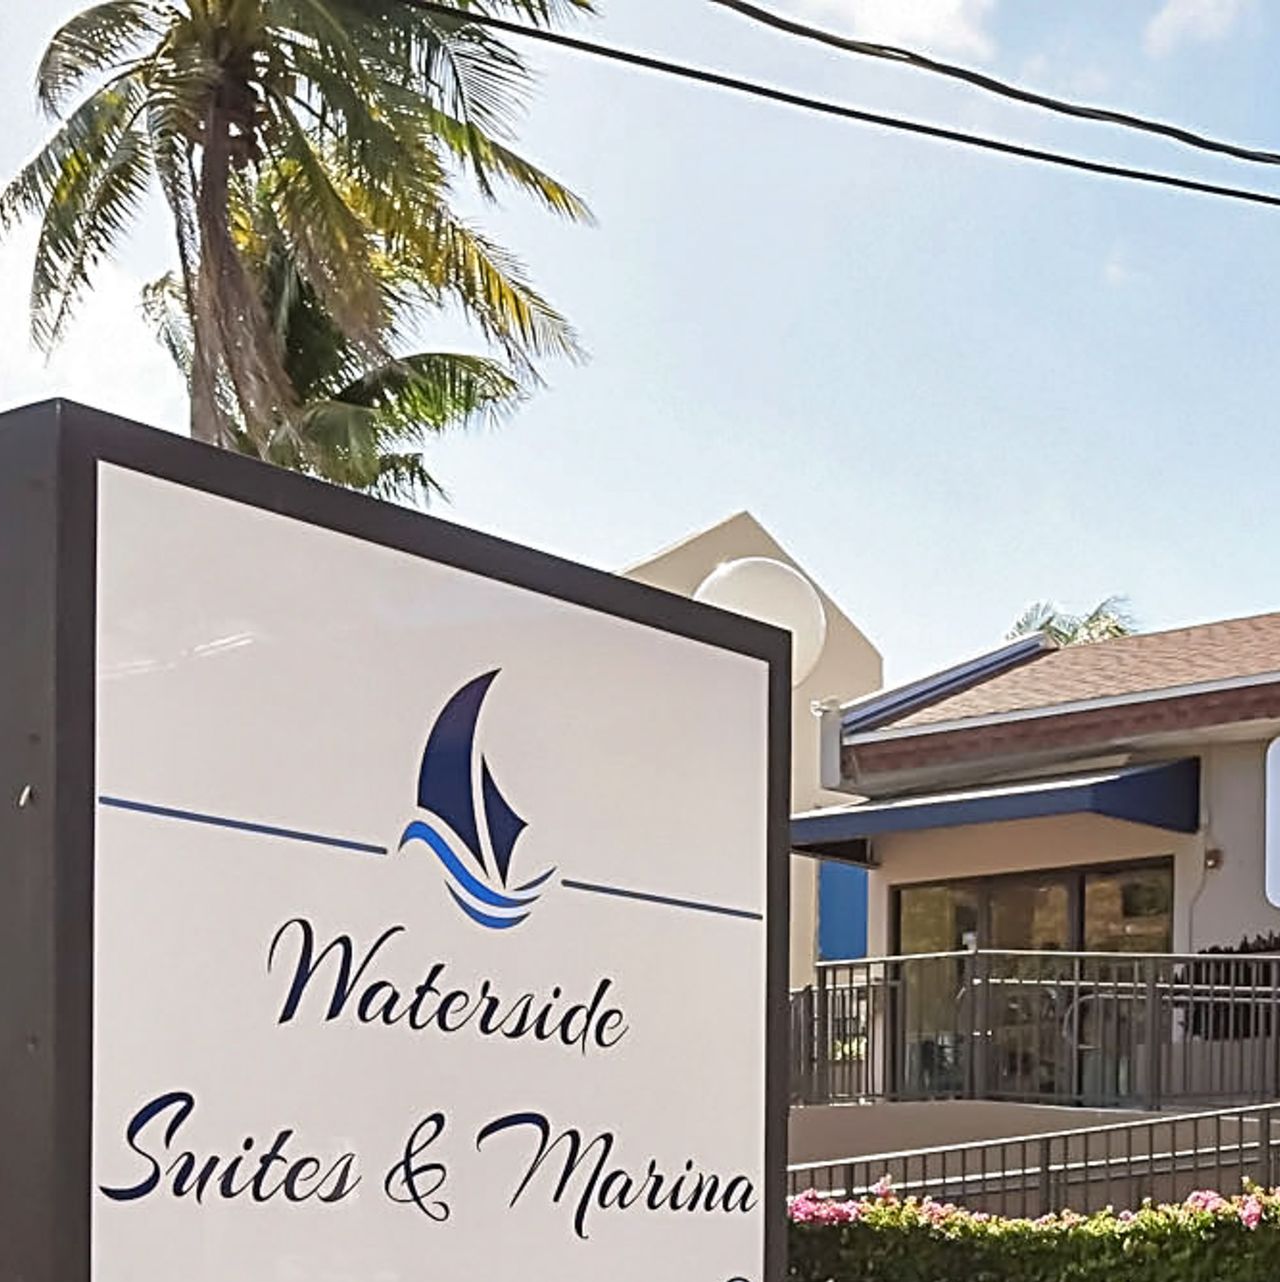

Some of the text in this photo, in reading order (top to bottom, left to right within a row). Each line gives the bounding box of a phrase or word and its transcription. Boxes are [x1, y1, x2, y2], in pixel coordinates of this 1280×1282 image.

[267, 917, 630, 1055] Waterside
[98, 1091, 758, 1240] Suites & Marina
